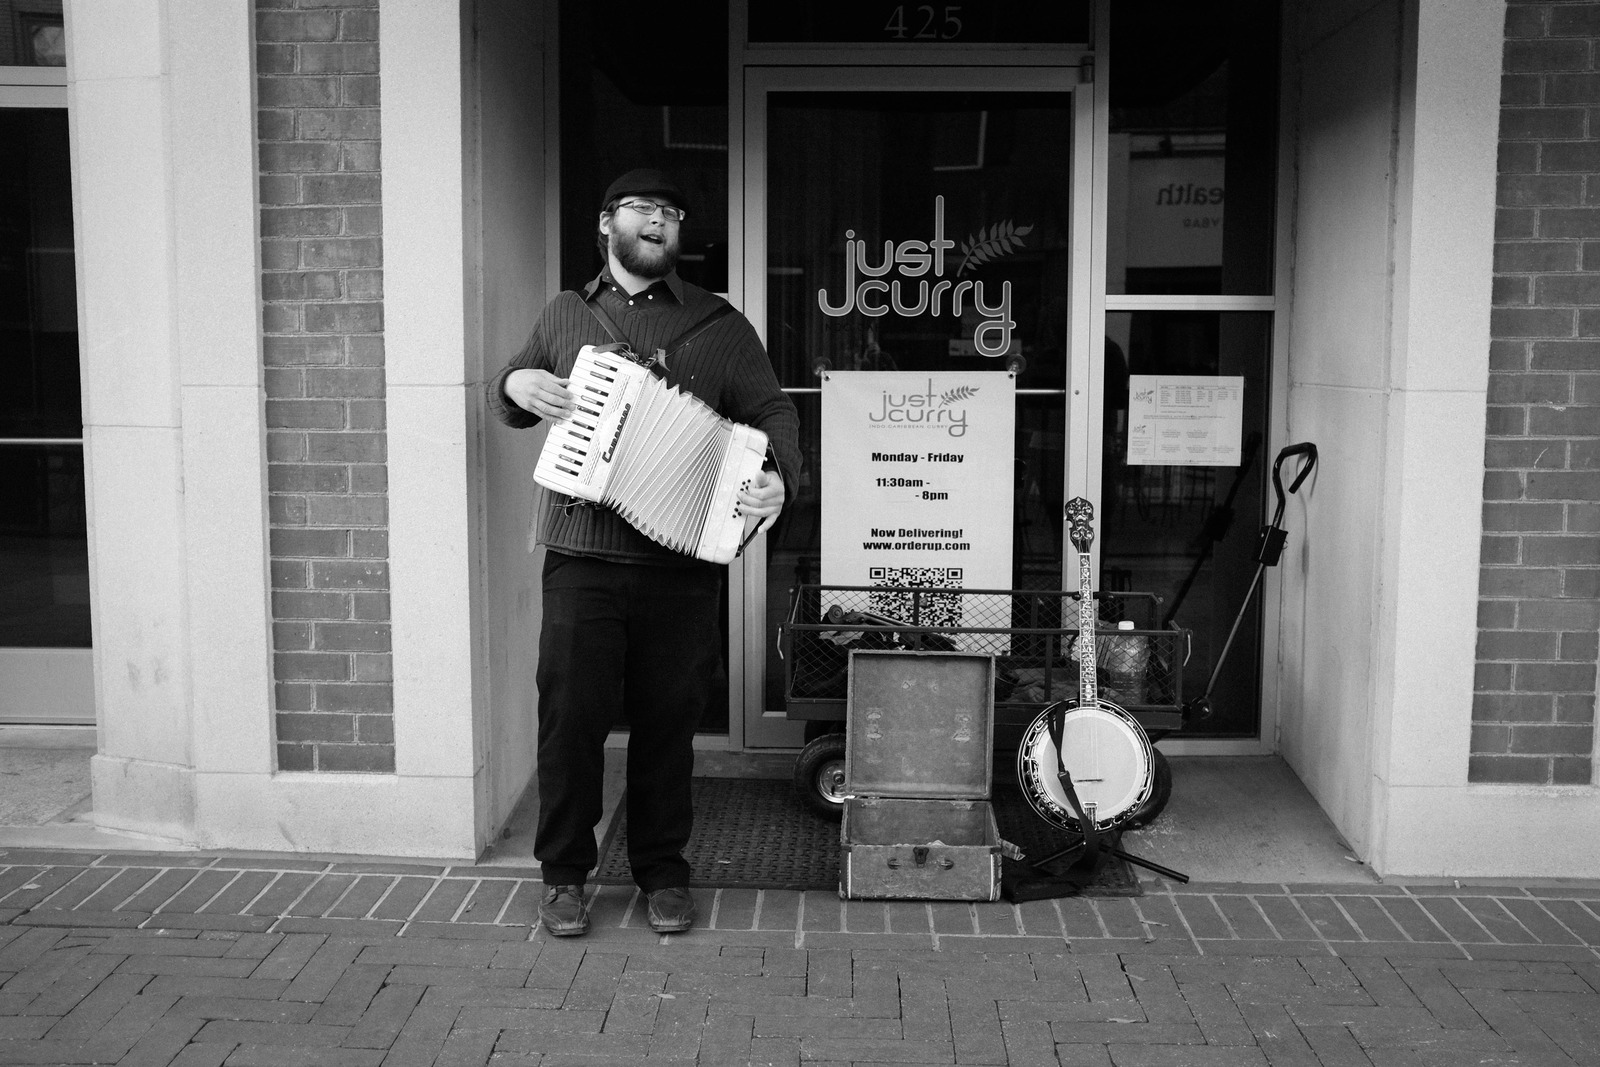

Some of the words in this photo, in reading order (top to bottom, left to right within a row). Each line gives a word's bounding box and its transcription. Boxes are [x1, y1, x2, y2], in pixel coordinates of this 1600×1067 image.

[884, 5, 962, 39] 425
[818, 195, 955, 317] just
[856, 280, 1017, 357] curry
[869, 378, 937, 422] just
[888, 409, 968, 437] curry
[871, 453, 918, 463] Monday
[927, 453, 964, 463] Friday
[875, 478, 923, 487] 11:30am
[922, 491, 948, 501] 8pm
[871, 528, 896, 538] Now
[898, 528, 963, 539] Delivering!
[863, 541, 970, 551] www.orderup.com
